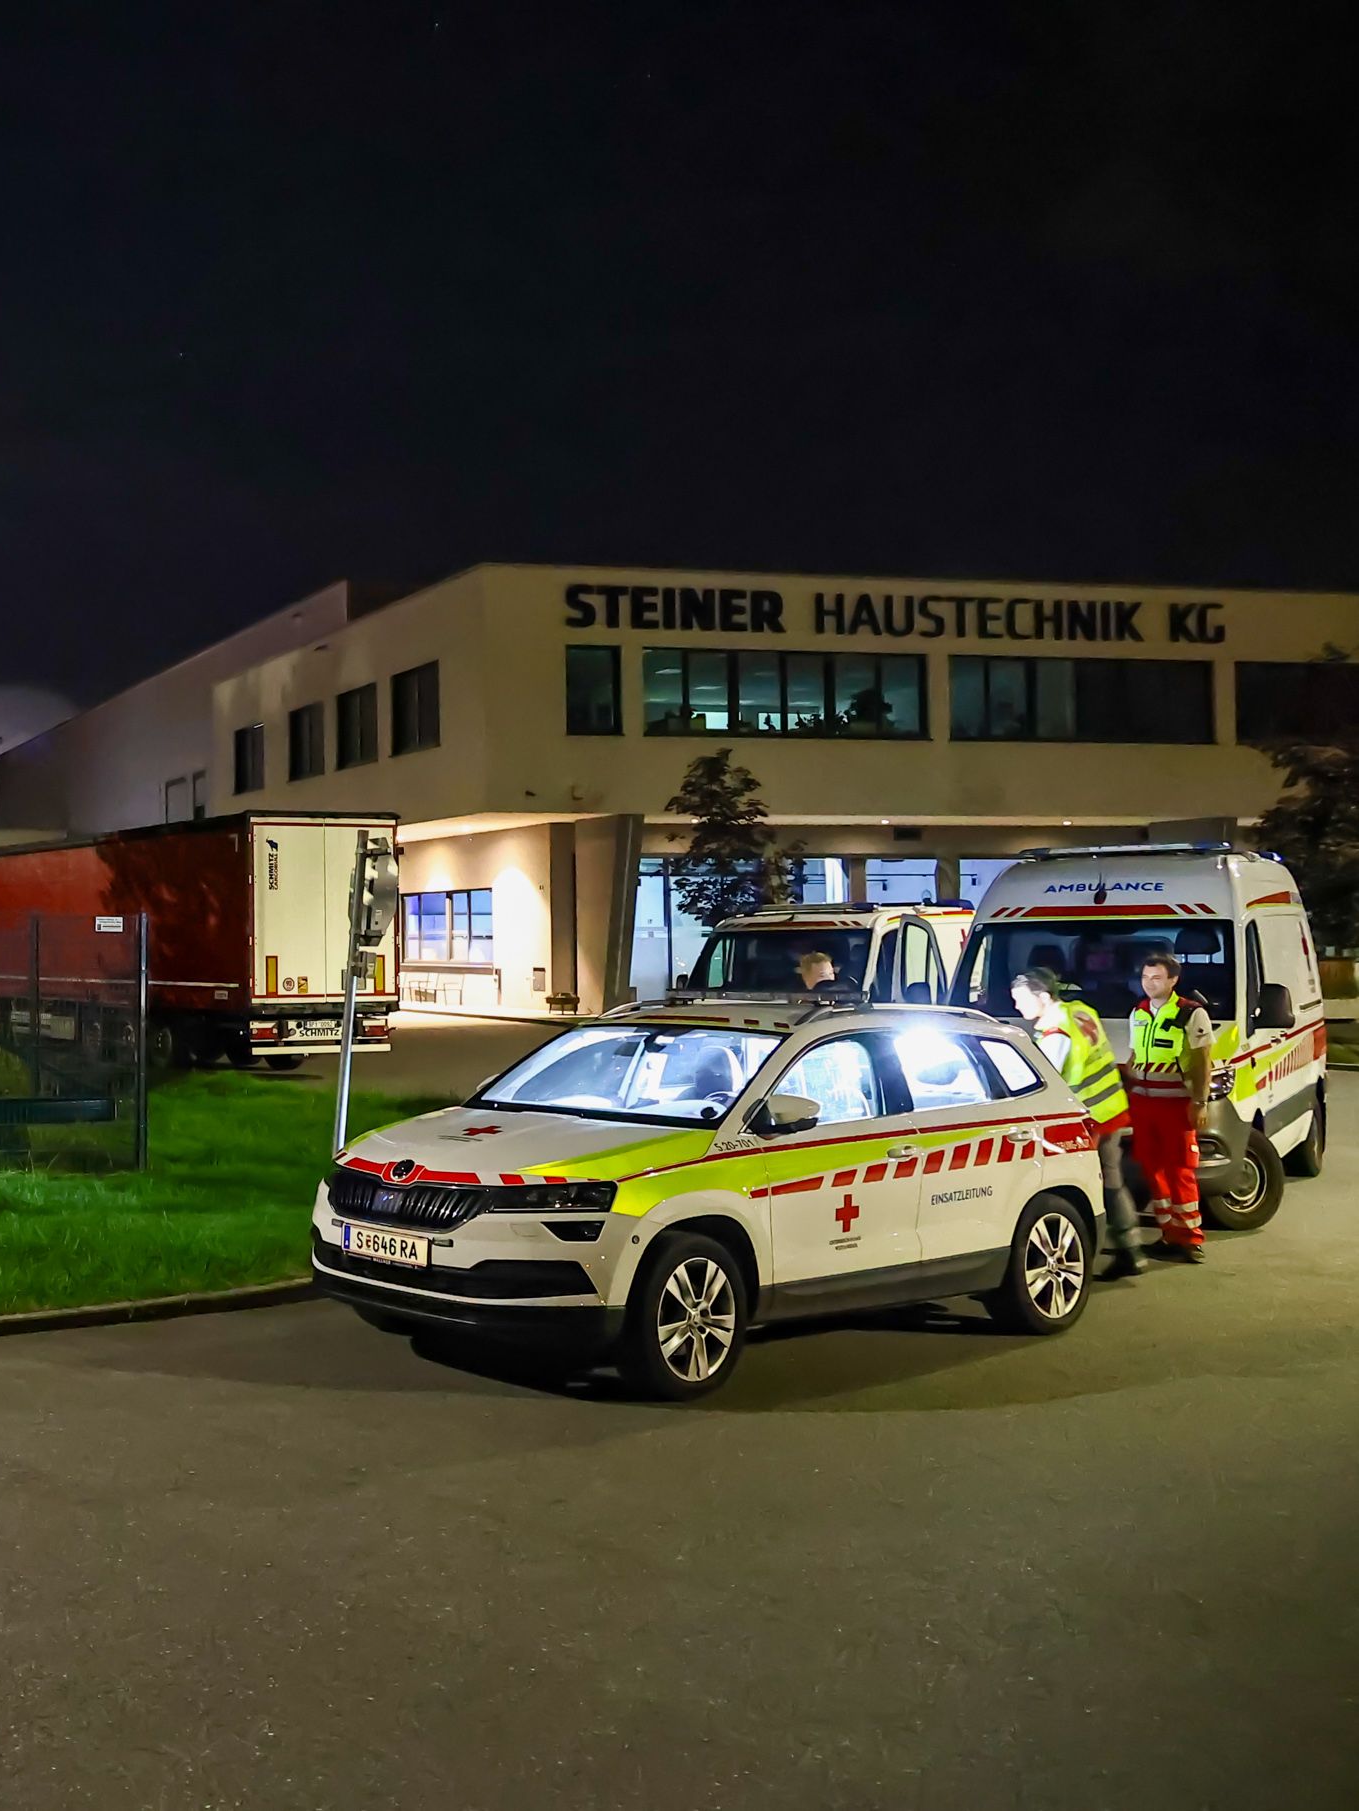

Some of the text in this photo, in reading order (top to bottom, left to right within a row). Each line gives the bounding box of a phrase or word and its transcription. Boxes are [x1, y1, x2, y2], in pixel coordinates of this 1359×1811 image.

[564, 584, 1226, 644] STEINER HAUSTECHNIK KG
[1044, 882, 1165, 894] AMBULANCE
[299, 1028, 340, 1038] SCHMITZ
[931, 1185, 993, 1205] EINSATZLEITUNG
[356, 1231, 418, 1260] S 646 RA
